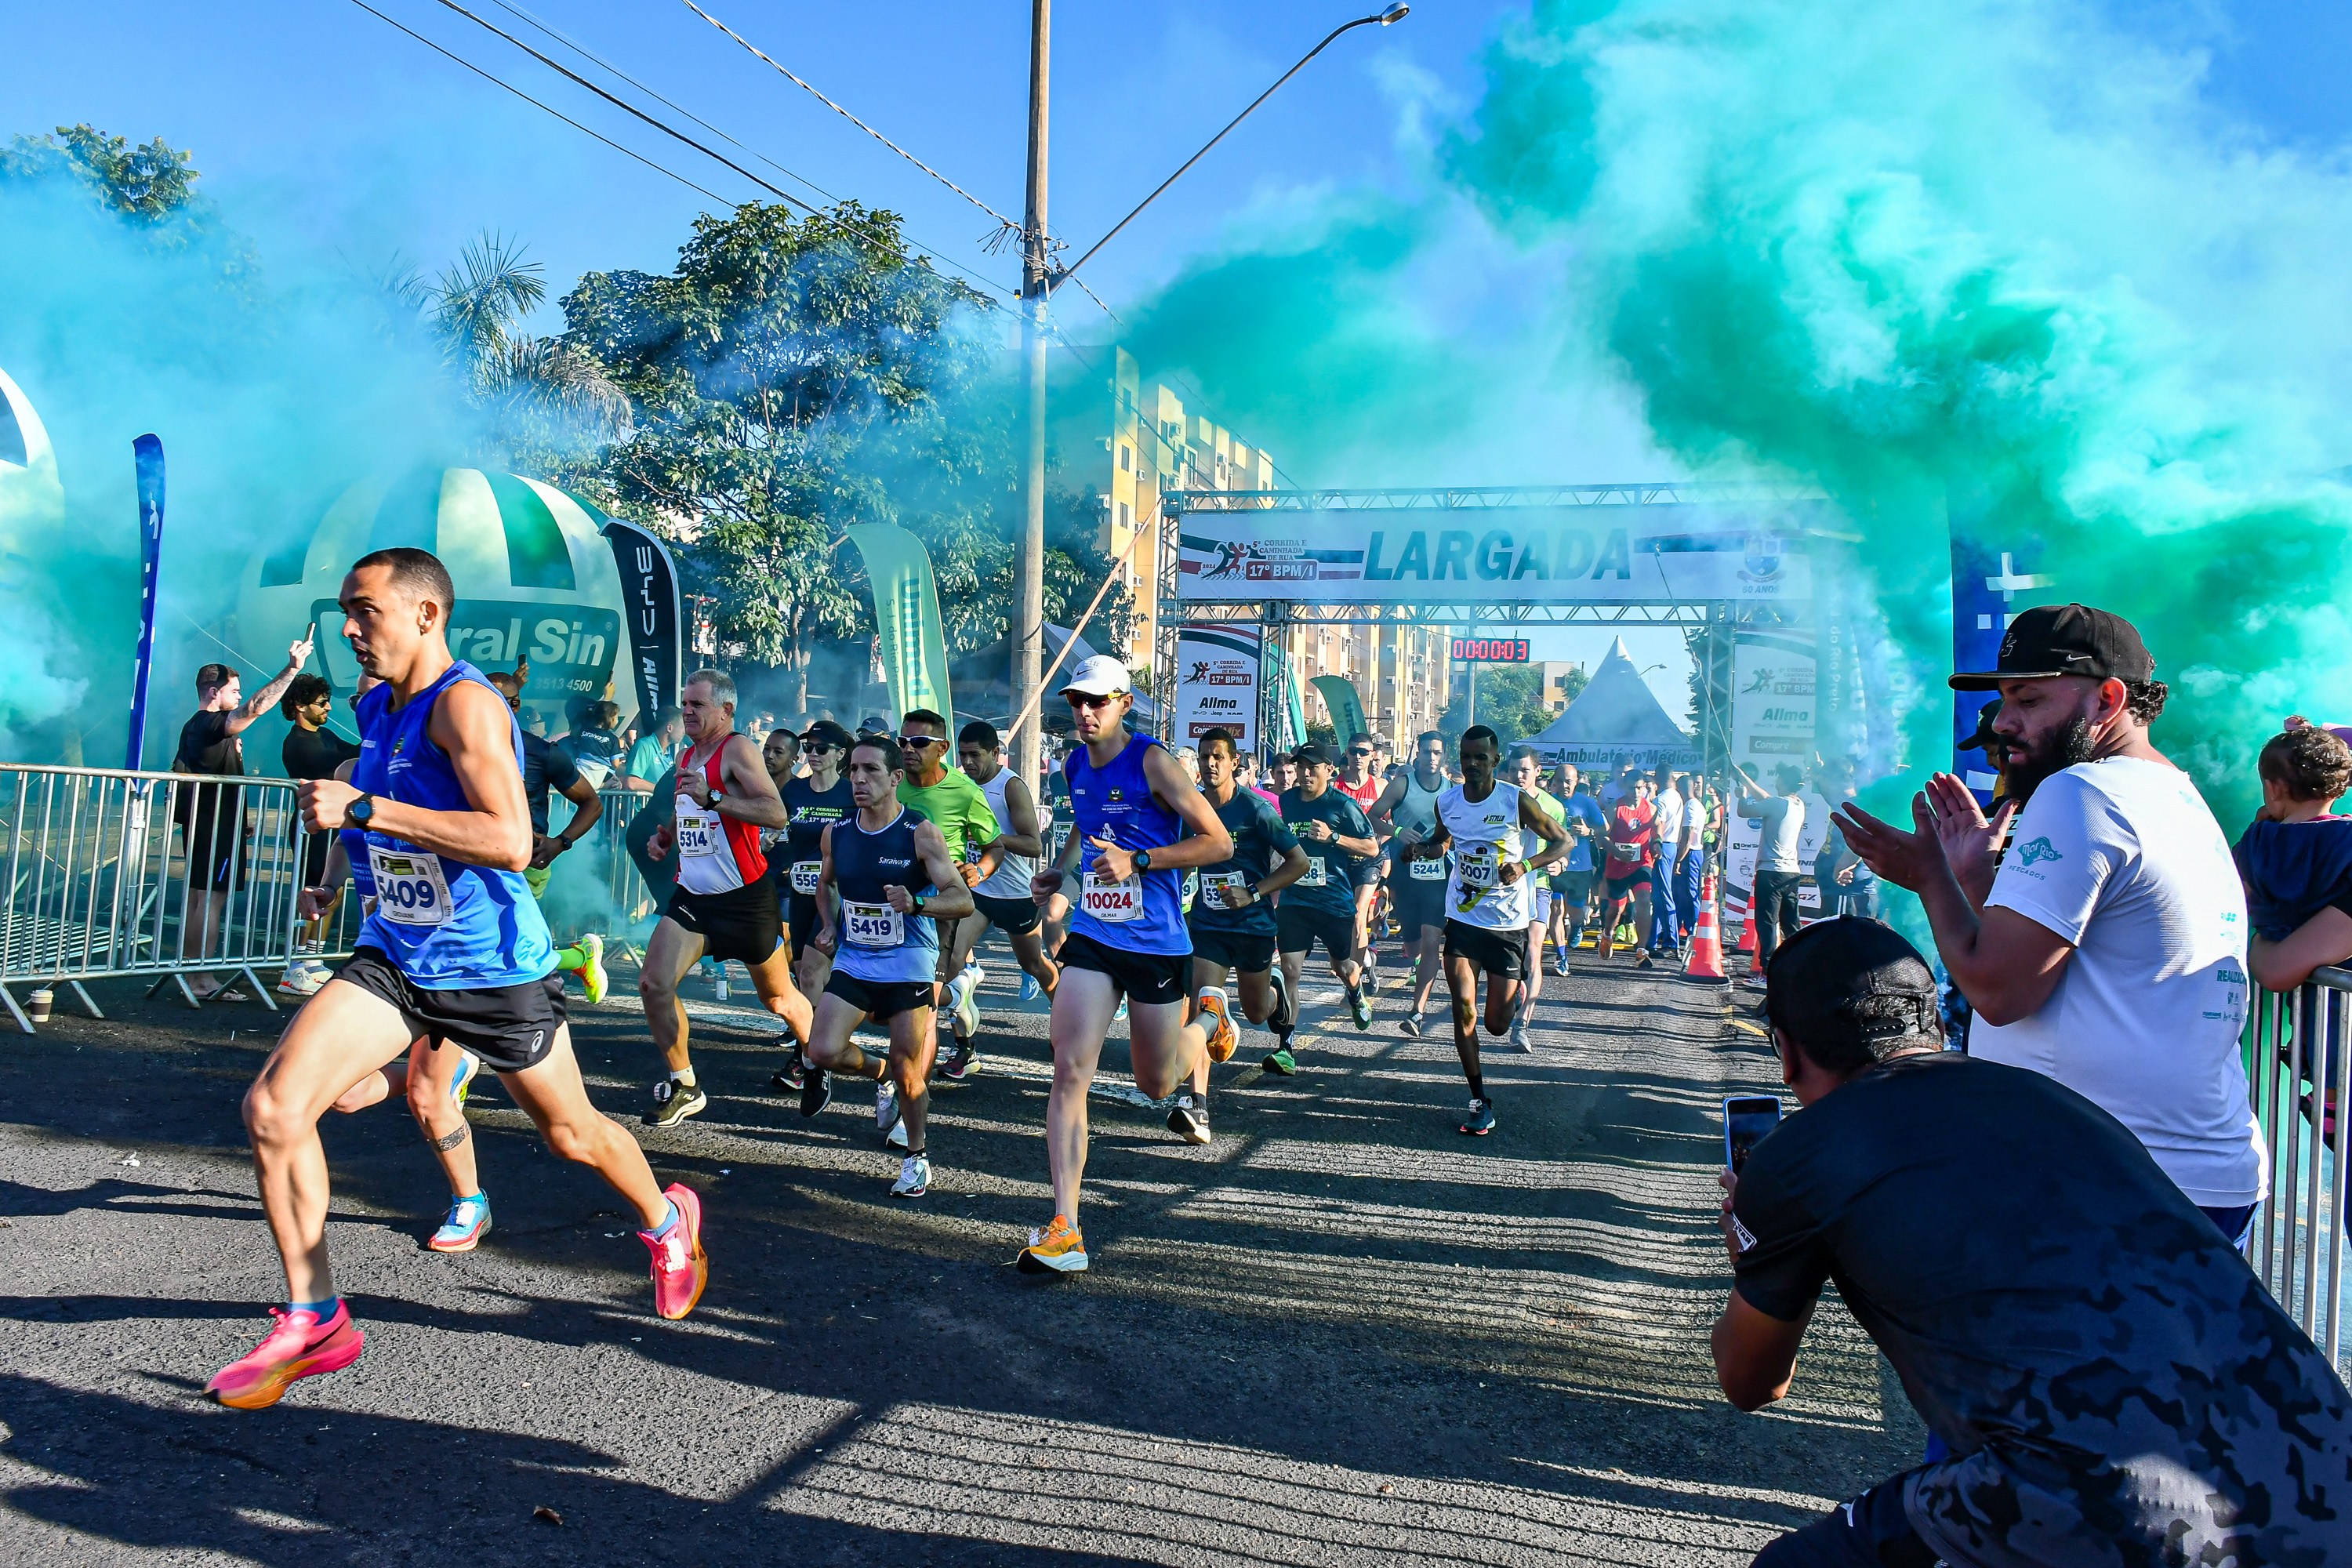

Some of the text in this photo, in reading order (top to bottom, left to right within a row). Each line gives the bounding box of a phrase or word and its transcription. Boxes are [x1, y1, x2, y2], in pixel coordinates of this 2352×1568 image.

[1363, 528, 1631, 582] LARGADA
[1272, 564, 1314, 579] BPM/I
[1755, 585, 1780, 593] ANOS
[448, 618, 606, 666] ral Sin
[887, 627, 897, 641] do
[901, 577, 930, 697] Unimed
[1830, 626, 1842, 644] do
[889, 644, 899, 664] Rio
[1453, 639, 1528, 661] 00:00:03
[1829, 648, 1842, 670] Rio
[566, 678, 593, 693] 4500
[1225, 675, 1250, 684] BPM/I
[1794, 684, 1815, 694] BPM
[1829, 673, 1841, 712] Preto
[1199, 697, 1237, 709] Allma
[1762, 708, 1809, 721] Allma
[1755, 740, 1789, 752] Compre
[1646, 748, 1698, 765] Médico
[680, 831, 708, 848] 5314
[2040, 844, 2054, 858] Rio
[878, 856, 902, 866] Saraiva
[1414, 863, 1440, 875] 5244
[1460, 862, 1491, 880] 5007
[2008, 865, 2046, 881] PESCADOS
[796, 873, 820, 887] 558
[377, 874, 436, 909] 5409
[1205, 887, 1221, 901] 53
[1086, 891, 1133, 909] 10024
[851, 916, 891, 936] 5419
